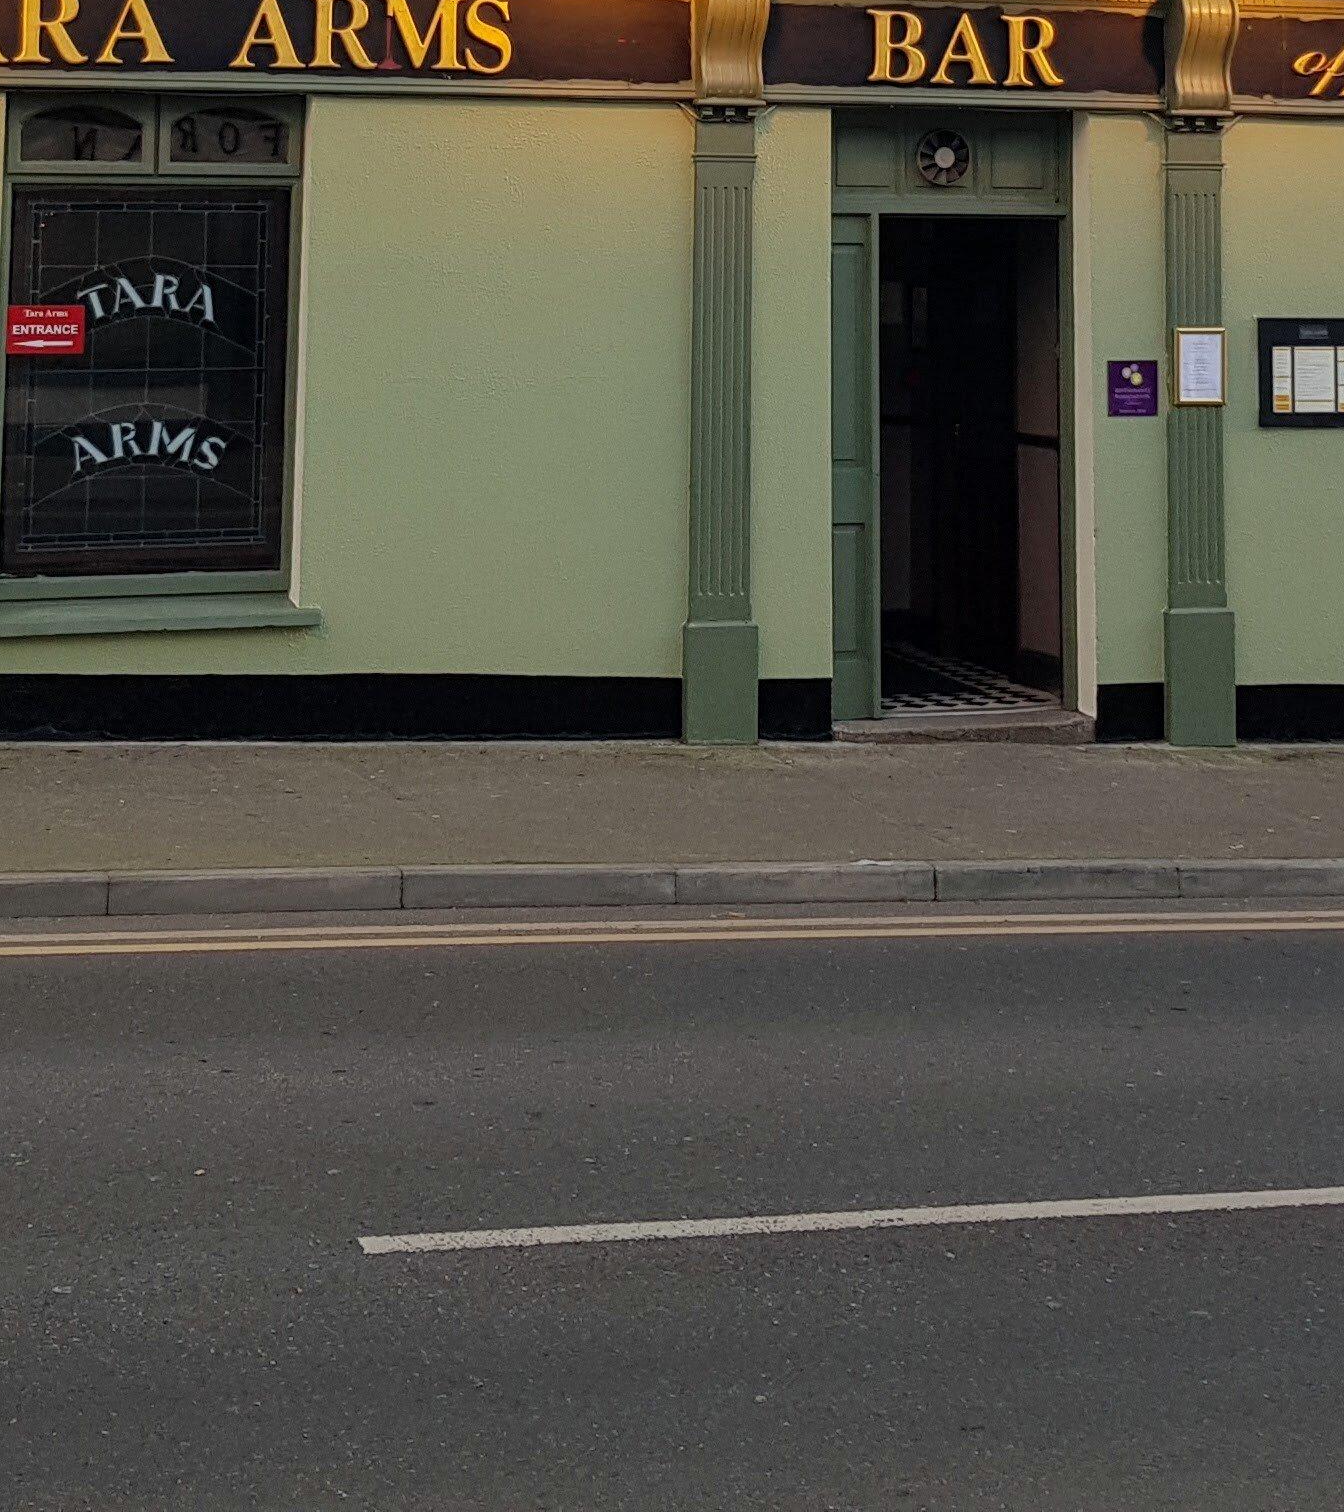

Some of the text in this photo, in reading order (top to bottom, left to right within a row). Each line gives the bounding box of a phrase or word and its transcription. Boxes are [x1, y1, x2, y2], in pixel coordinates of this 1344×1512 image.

[866, 8, 1065, 87] BAR
[76, 273, 216, 324] TARA
[12, 324, 79, 335] ENTRANCE
[72, 420, 228, 473] ARMS
